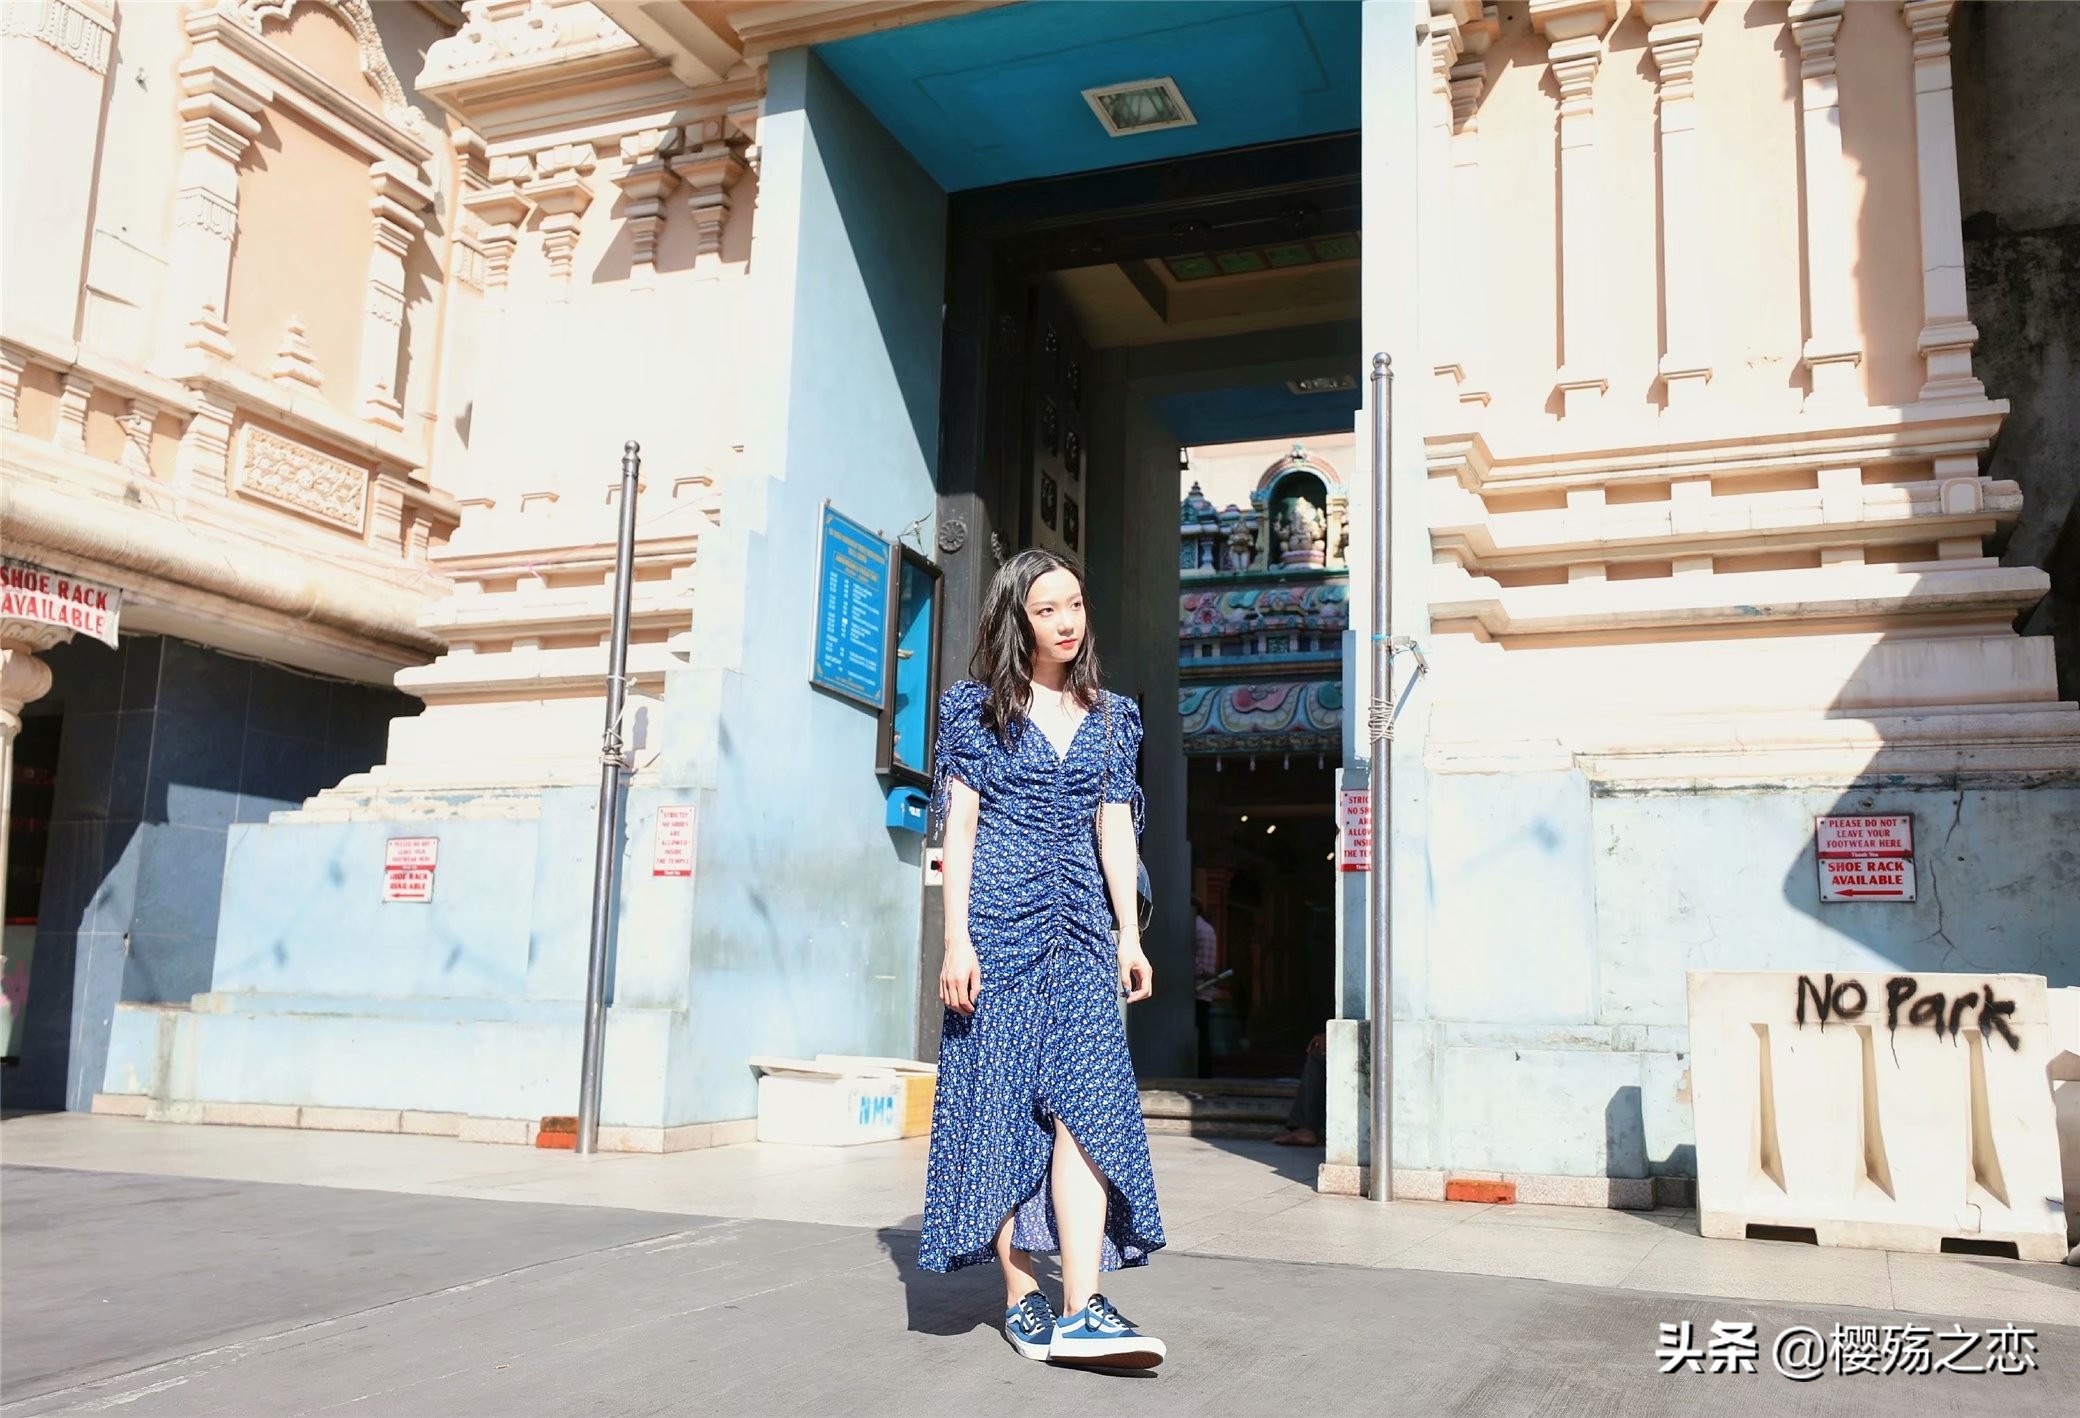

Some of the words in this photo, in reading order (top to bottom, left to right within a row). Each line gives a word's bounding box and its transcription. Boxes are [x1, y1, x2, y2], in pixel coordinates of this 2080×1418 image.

[0, 566, 50, 594] SHOE
[58, 579, 107, 611] RACK
[1, 591, 103, 635] AVAILABLE
[1829, 819, 1861, 828] PLEASE
[1865, 819, 1877, 827] DO
[1880, 819, 1897, 827] NOT
[1837, 830, 1863, 838] LEAVE
[1867, 829, 1890, 837] YOUR
[1828, 862, 1862, 871] SHOE
[1867, 862, 1904, 871] RACK
[1832, 875, 1904, 885] AVAILABLE
[1796, 973, 1867, 1033] NO
[1886, 976, 2019, 1069] Park
